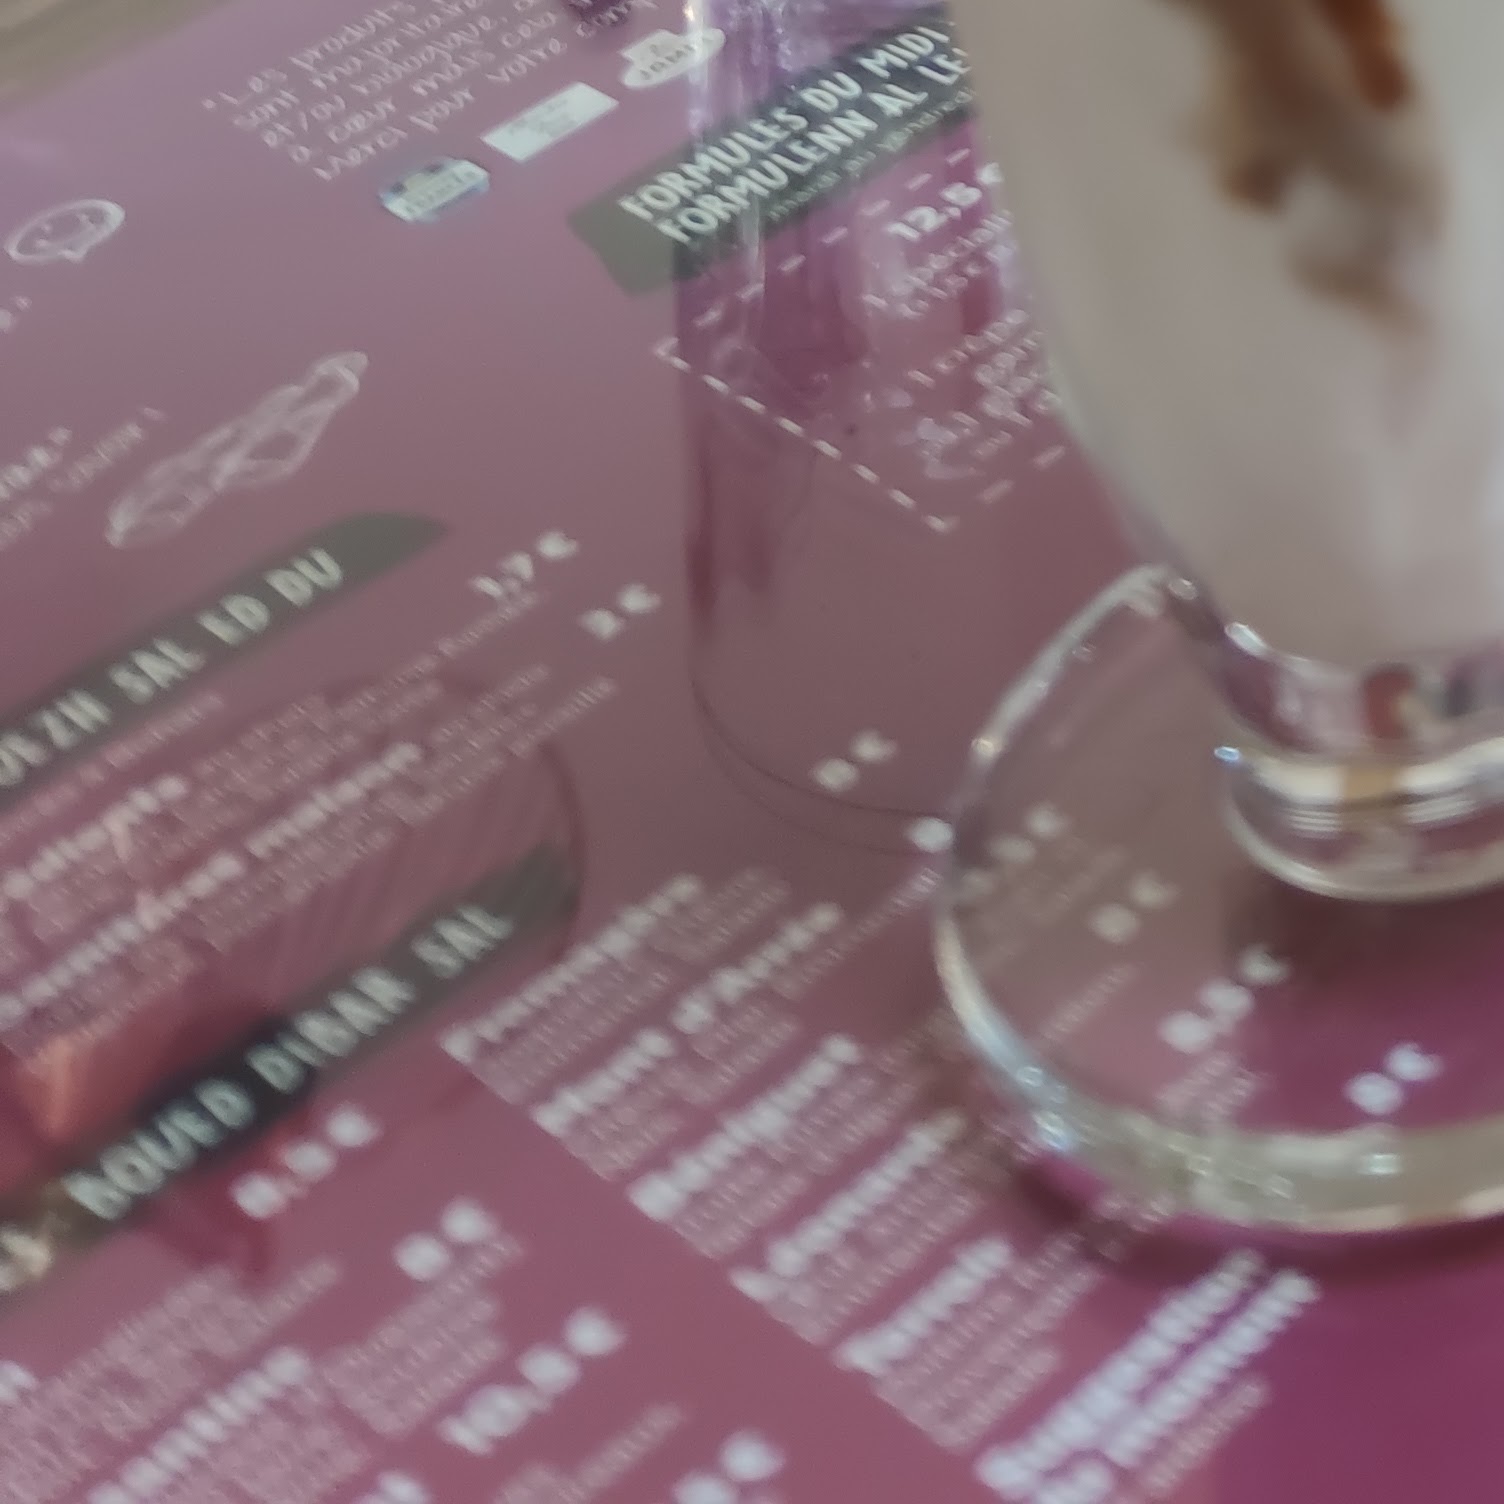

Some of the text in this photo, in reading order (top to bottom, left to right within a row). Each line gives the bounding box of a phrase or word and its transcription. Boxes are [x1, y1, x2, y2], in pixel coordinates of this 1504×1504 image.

[618, 107, 809, 221] FORMULES
[802, 71, 863, 113] DU
[859, 25, 950, 79] MIDI
[655, 108, 878, 246] FORMULENN
[870, 82, 929, 117] AL
[265, 548, 344, 609] DU
